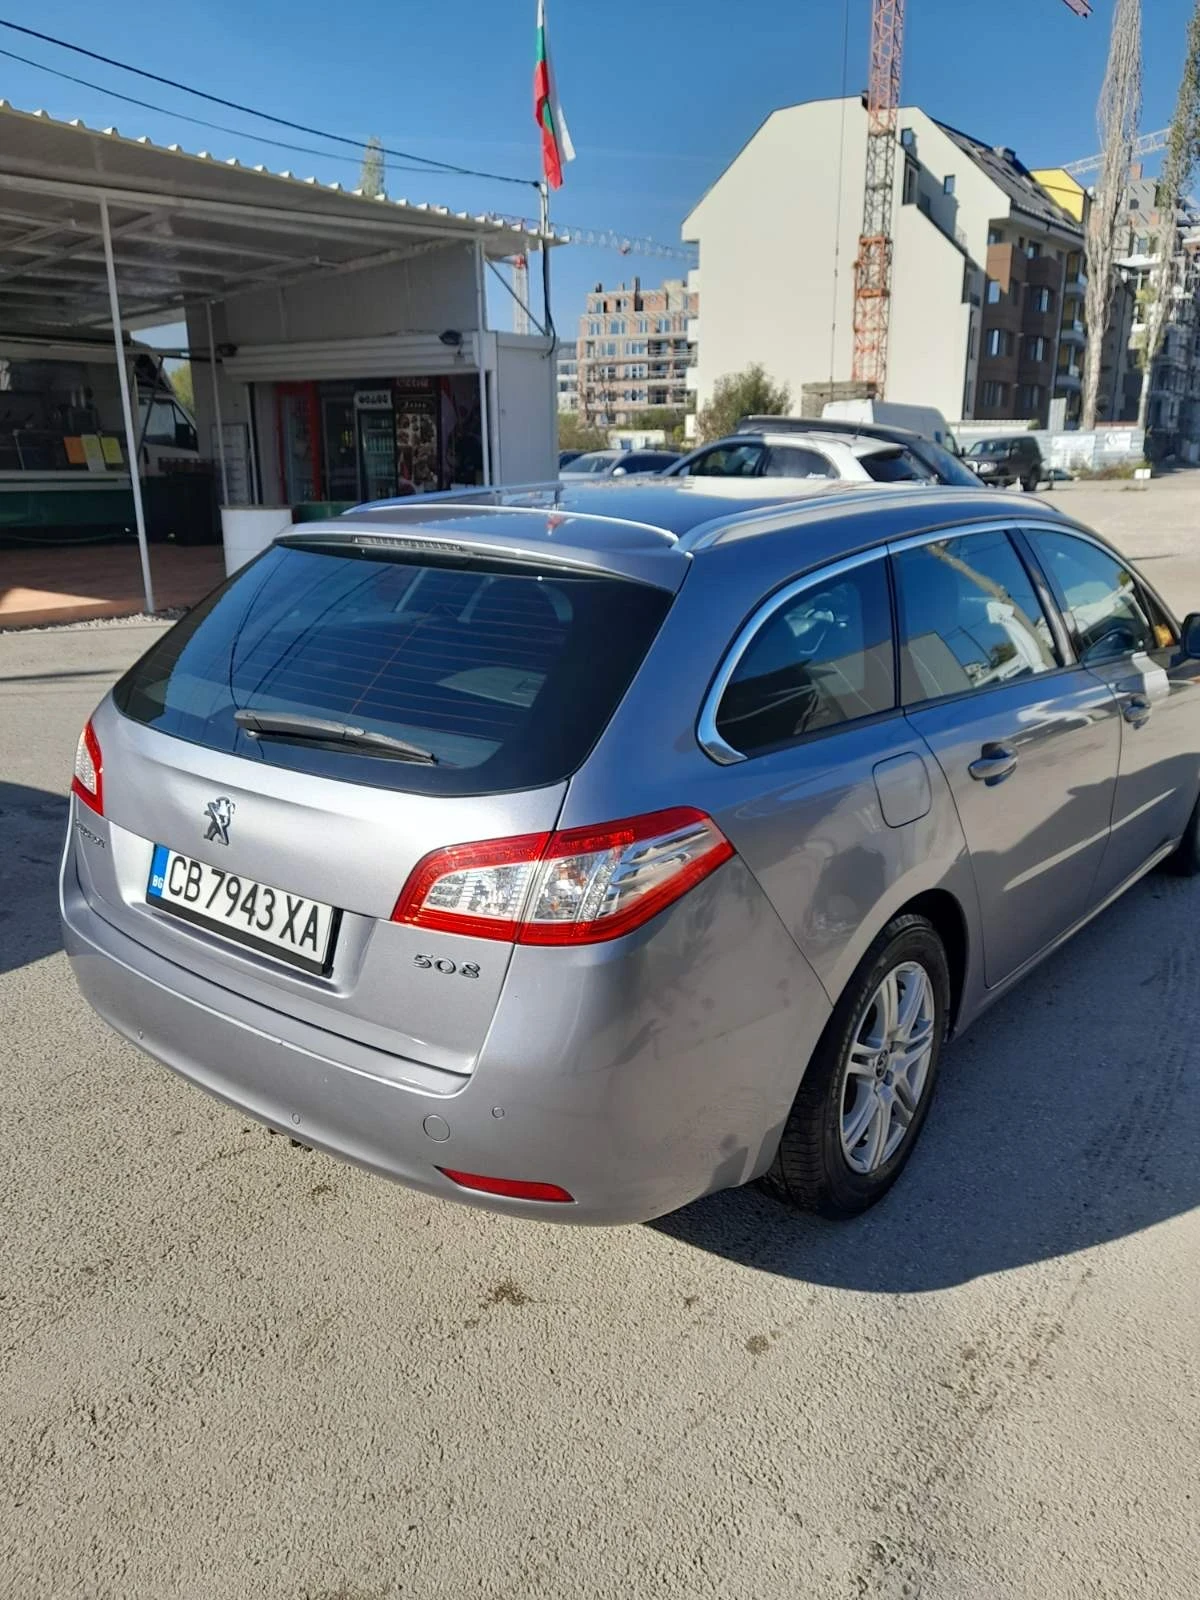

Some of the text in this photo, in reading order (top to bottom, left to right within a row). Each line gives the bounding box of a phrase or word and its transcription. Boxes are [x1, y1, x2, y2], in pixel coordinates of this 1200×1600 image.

[152, 874, 164, 889] BG
[168, 855, 319, 953] CB 7943 XA
[412, 953, 481, 979] 508
